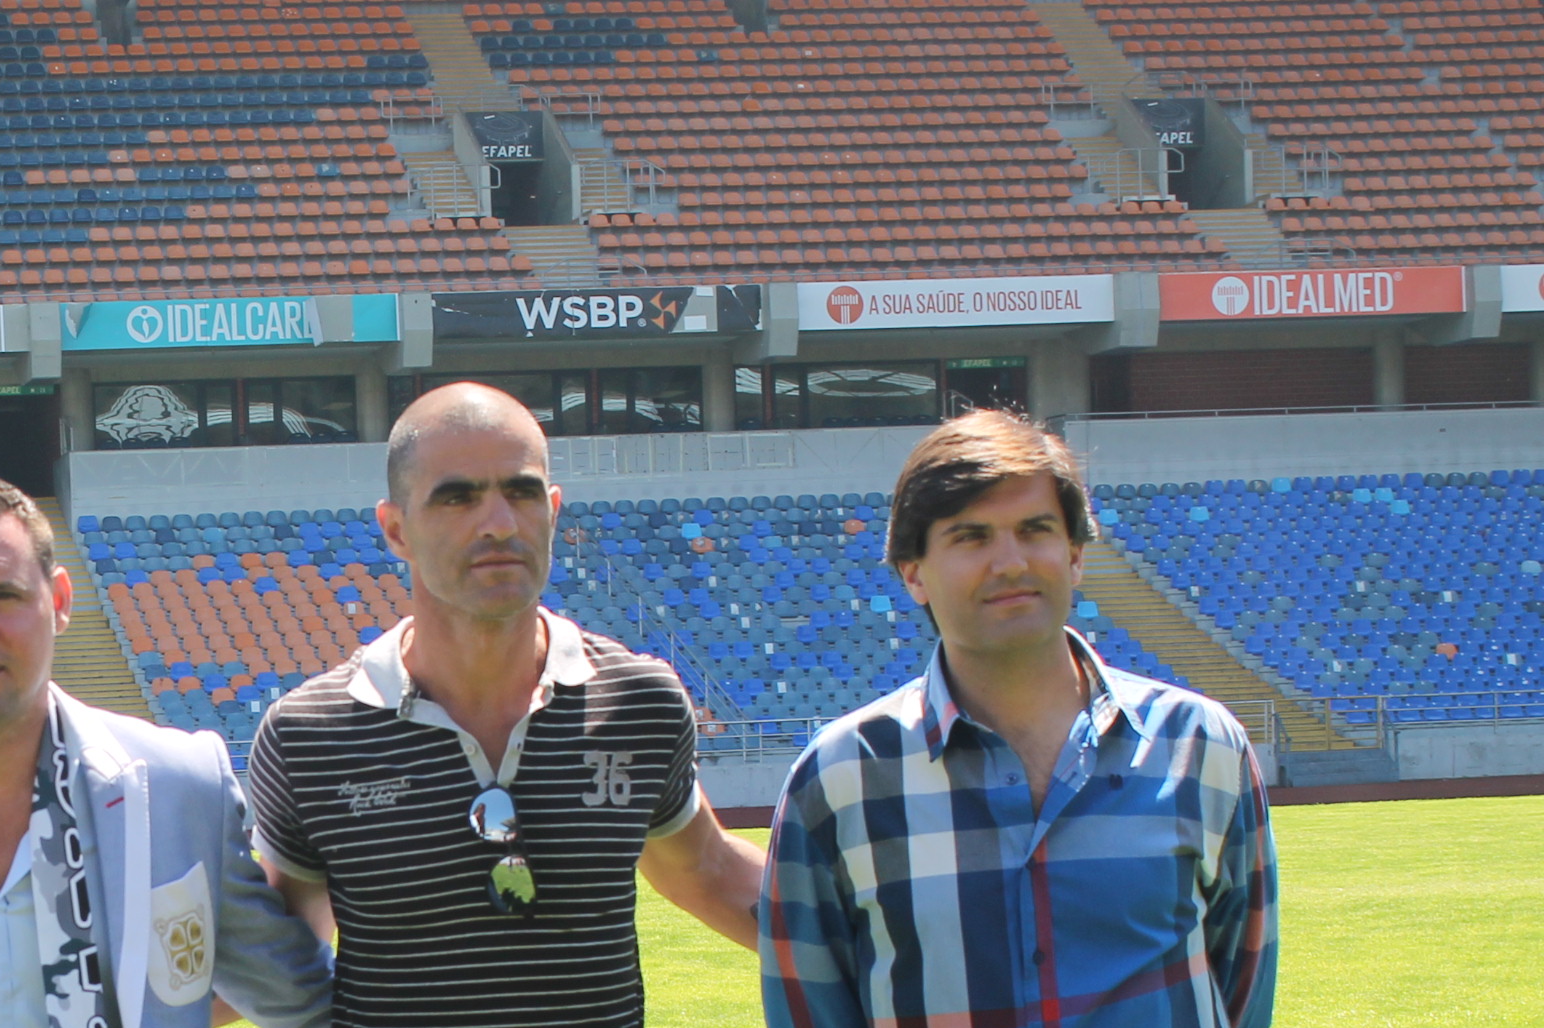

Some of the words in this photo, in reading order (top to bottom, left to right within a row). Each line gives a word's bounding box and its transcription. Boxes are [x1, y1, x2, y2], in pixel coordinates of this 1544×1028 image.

[1155, 132, 1194, 144] APEL
[869, 296, 880, 314] A
[883, 294, 913, 314] SUA
[916, 290, 970, 314] SAÚDE,
[973, 293, 983, 312] O
[987, 291, 1039, 311] NOSSO
[1041, 290, 1082, 311] IDEAL
[582, 752, 632, 806] 36
